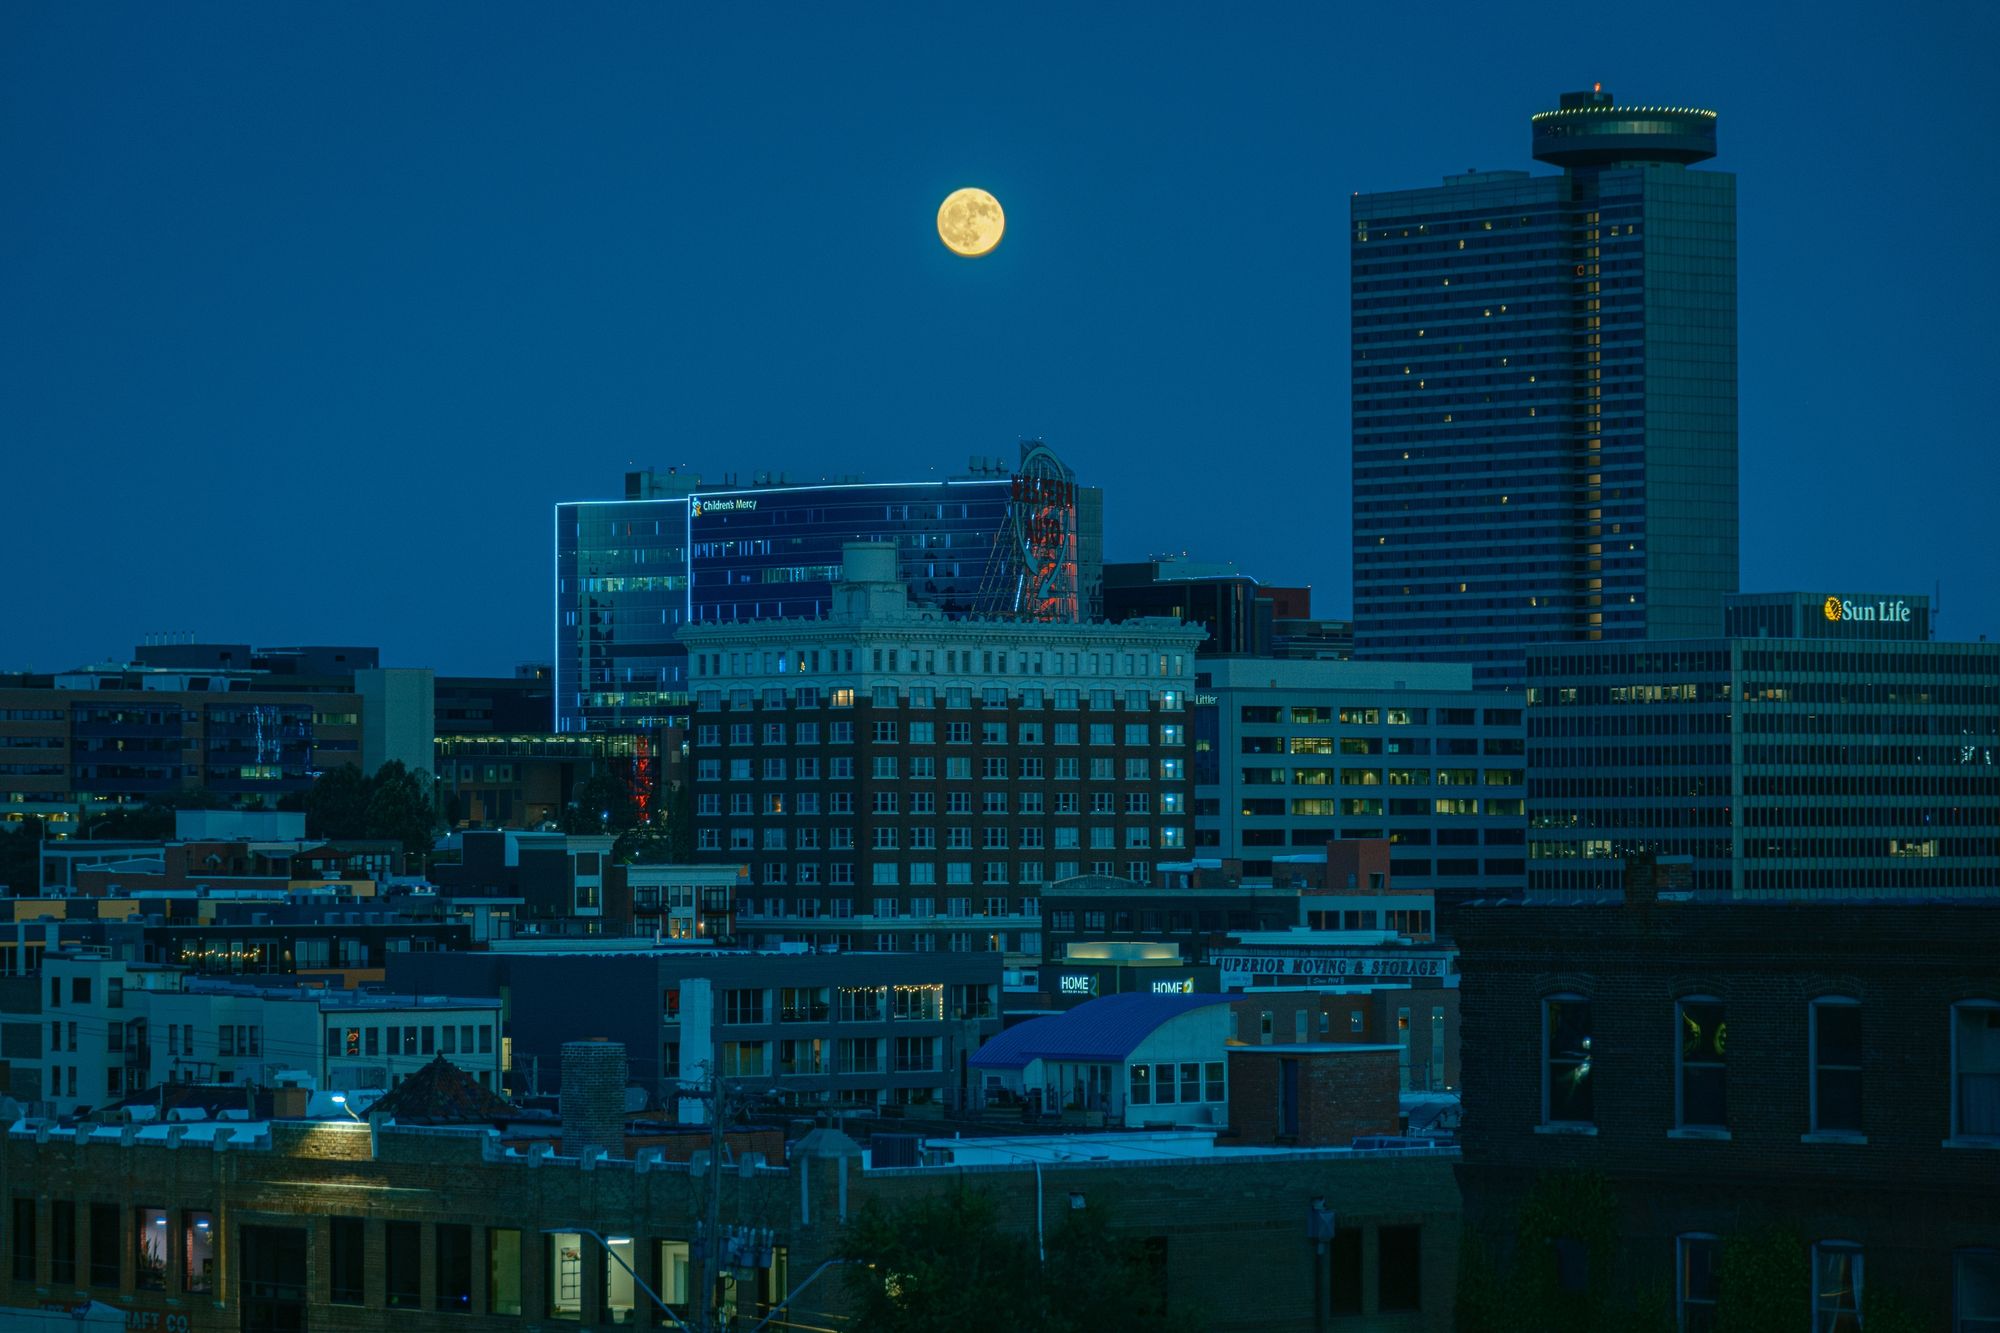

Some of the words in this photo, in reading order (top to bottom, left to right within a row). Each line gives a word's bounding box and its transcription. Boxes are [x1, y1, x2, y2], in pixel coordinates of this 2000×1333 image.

[703, 500, 735, 511] Children's
[736, 499, 757, 511] Mercy
[1842, 600, 1876, 621] Sun
[1878, 600, 1911, 622] Life
[1195, 694, 1218, 705] Littler
[1292, 958, 1347, 975] MOVING
[1353, 960, 1364, 975] &
[1371, 960, 1437, 976] STORAGE
[1061, 976, 1089, 989] HOME
[1152, 981, 1182, 993] HOME
